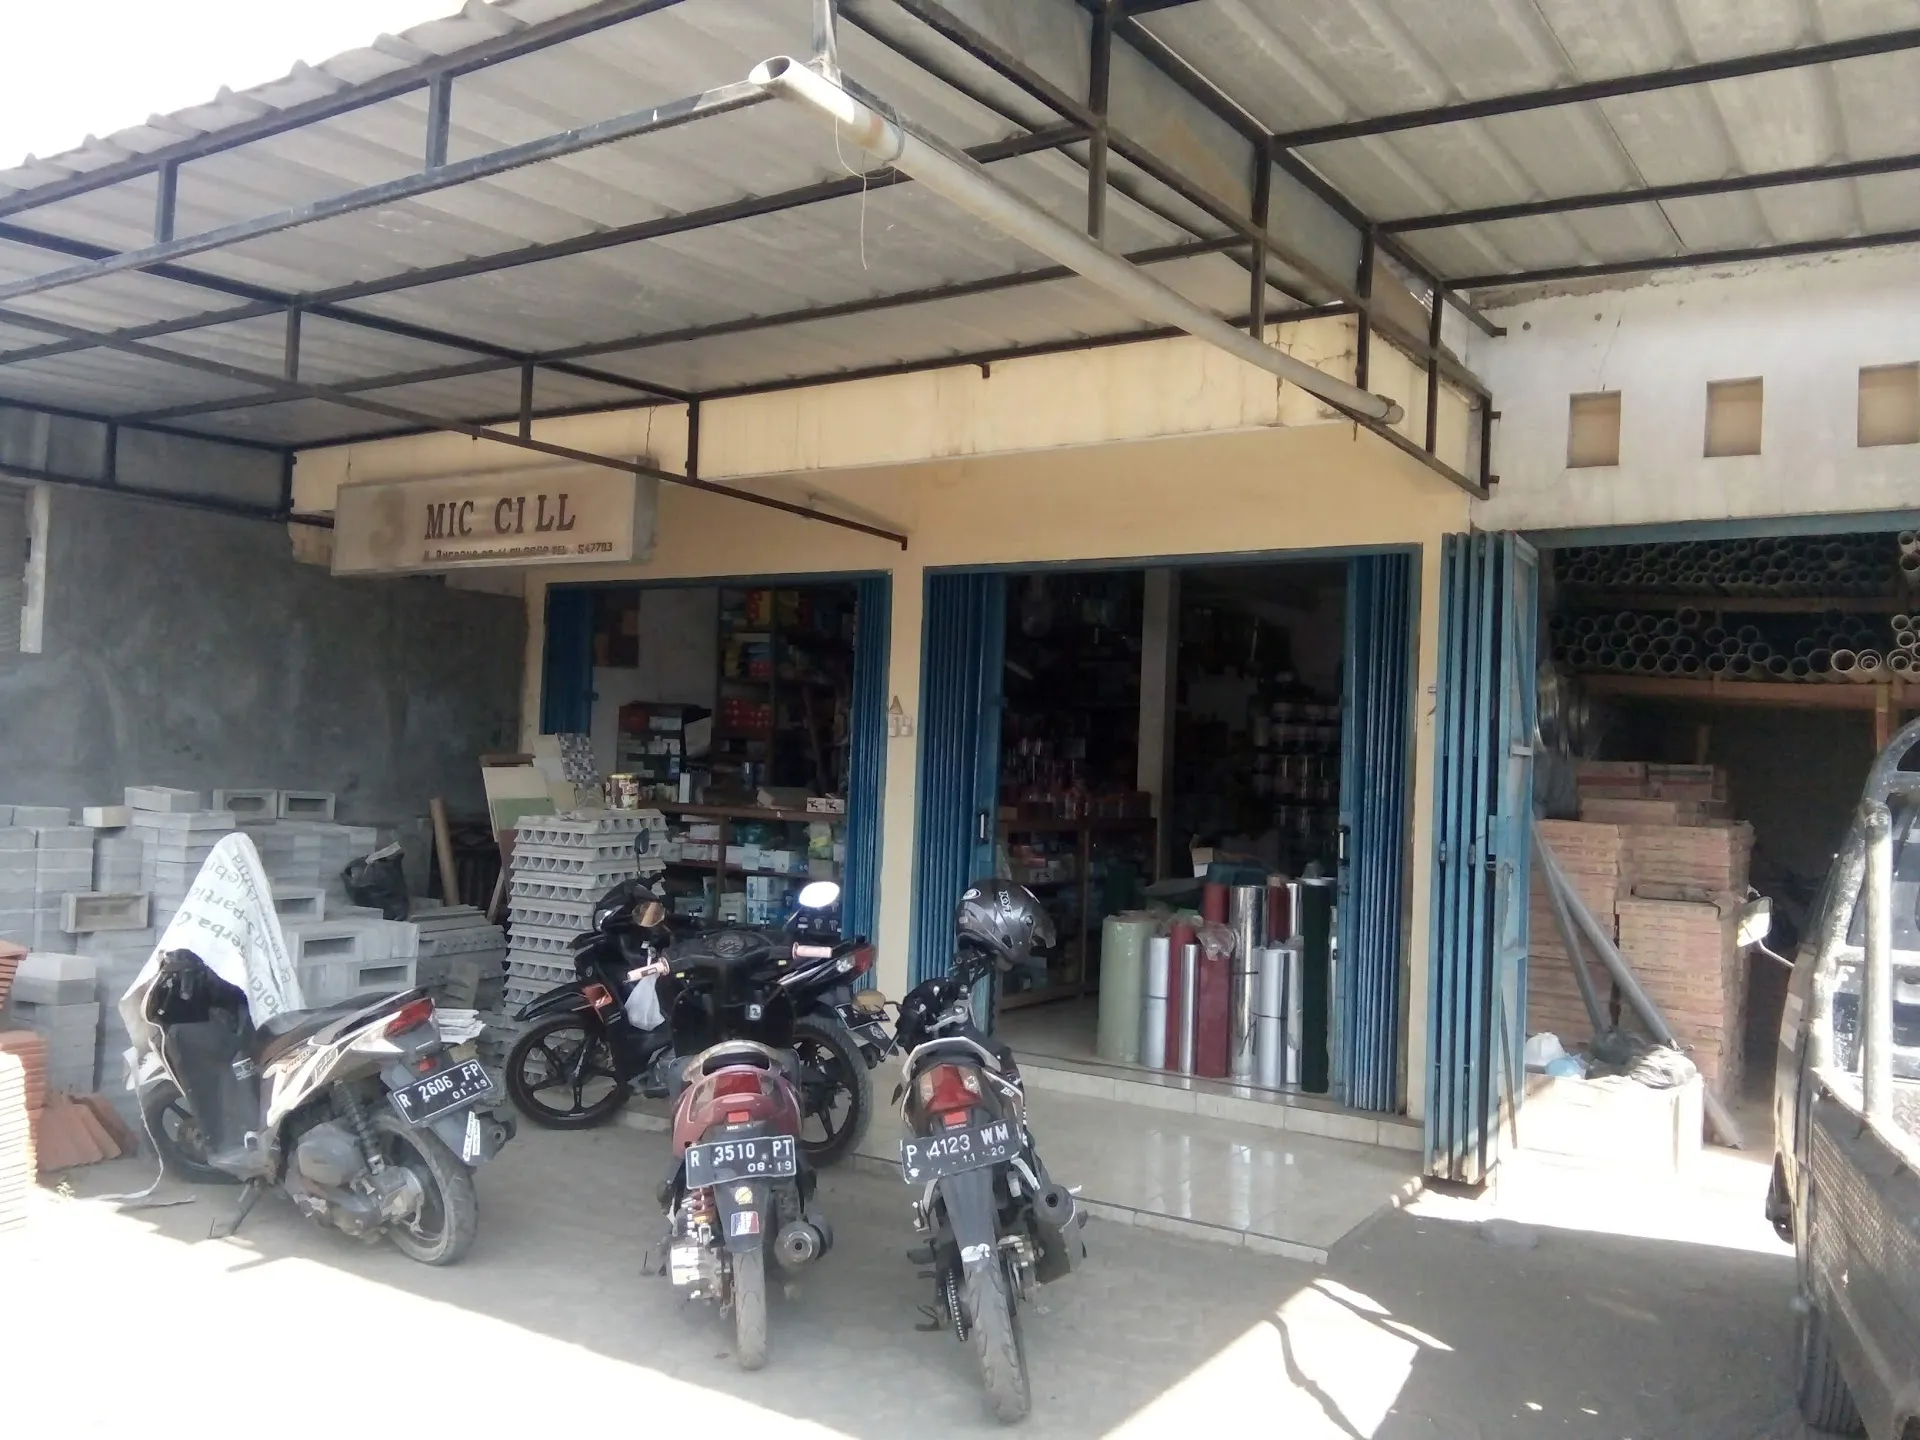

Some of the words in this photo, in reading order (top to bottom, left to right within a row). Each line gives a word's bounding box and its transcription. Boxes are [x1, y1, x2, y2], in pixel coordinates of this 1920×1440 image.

[424, 500, 474, 540] MIC
[398, 1093, 412, 1108] R
[418, 1075, 453, 1100] 2606
[461, 1063, 479, 1080] FP
[690, 1150, 700, 1167] R
[714, 1143, 755, 1164] 3510
[772, 1139, 792, 1157] PT
[906, 1144, 917, 1163] P
[929, 1134, 970, 1157] 4123
[981, 1123, 1009, 1145] WM
